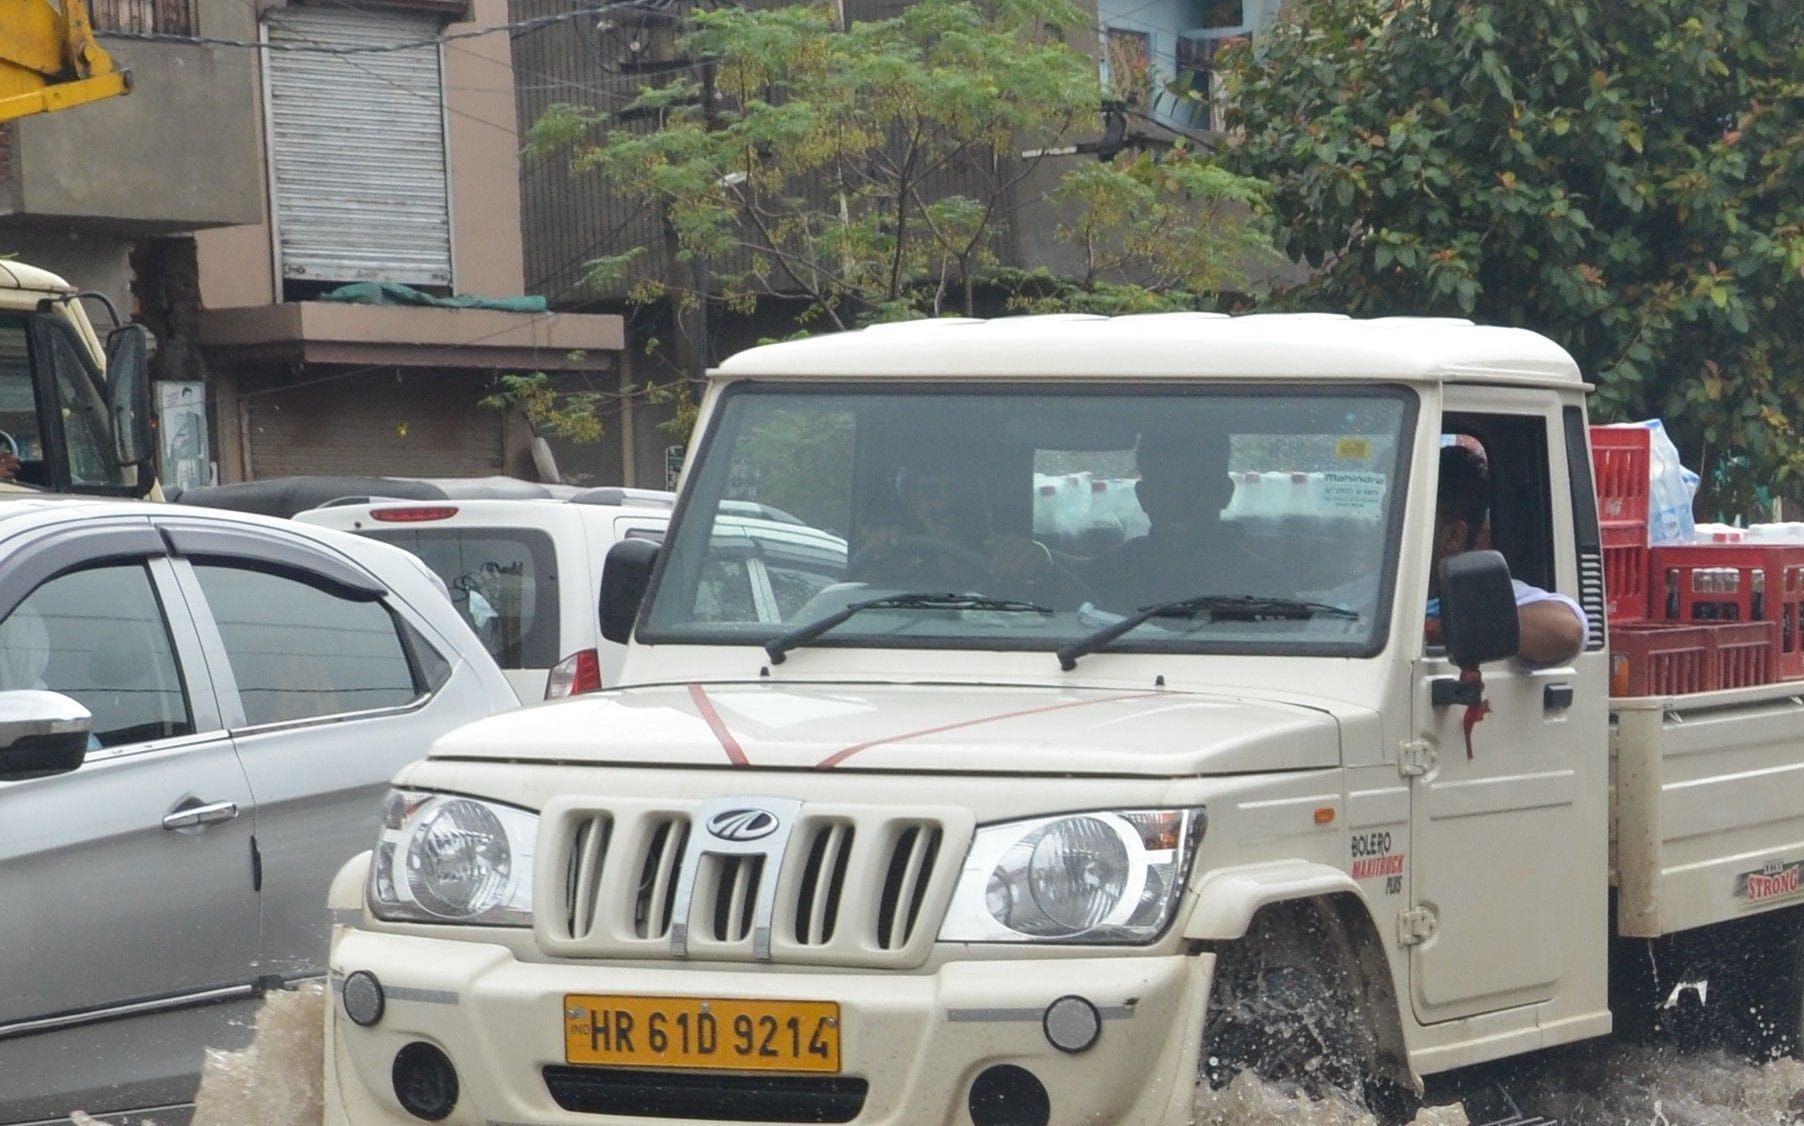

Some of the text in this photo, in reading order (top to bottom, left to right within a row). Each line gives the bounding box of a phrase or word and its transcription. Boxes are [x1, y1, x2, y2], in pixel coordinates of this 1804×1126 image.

[1351, 831, 1392, 858] BOLERO
[1748, 867, 1799, 901] STRONG
[590, 1009, 830, 1059] HR 61D 9214
